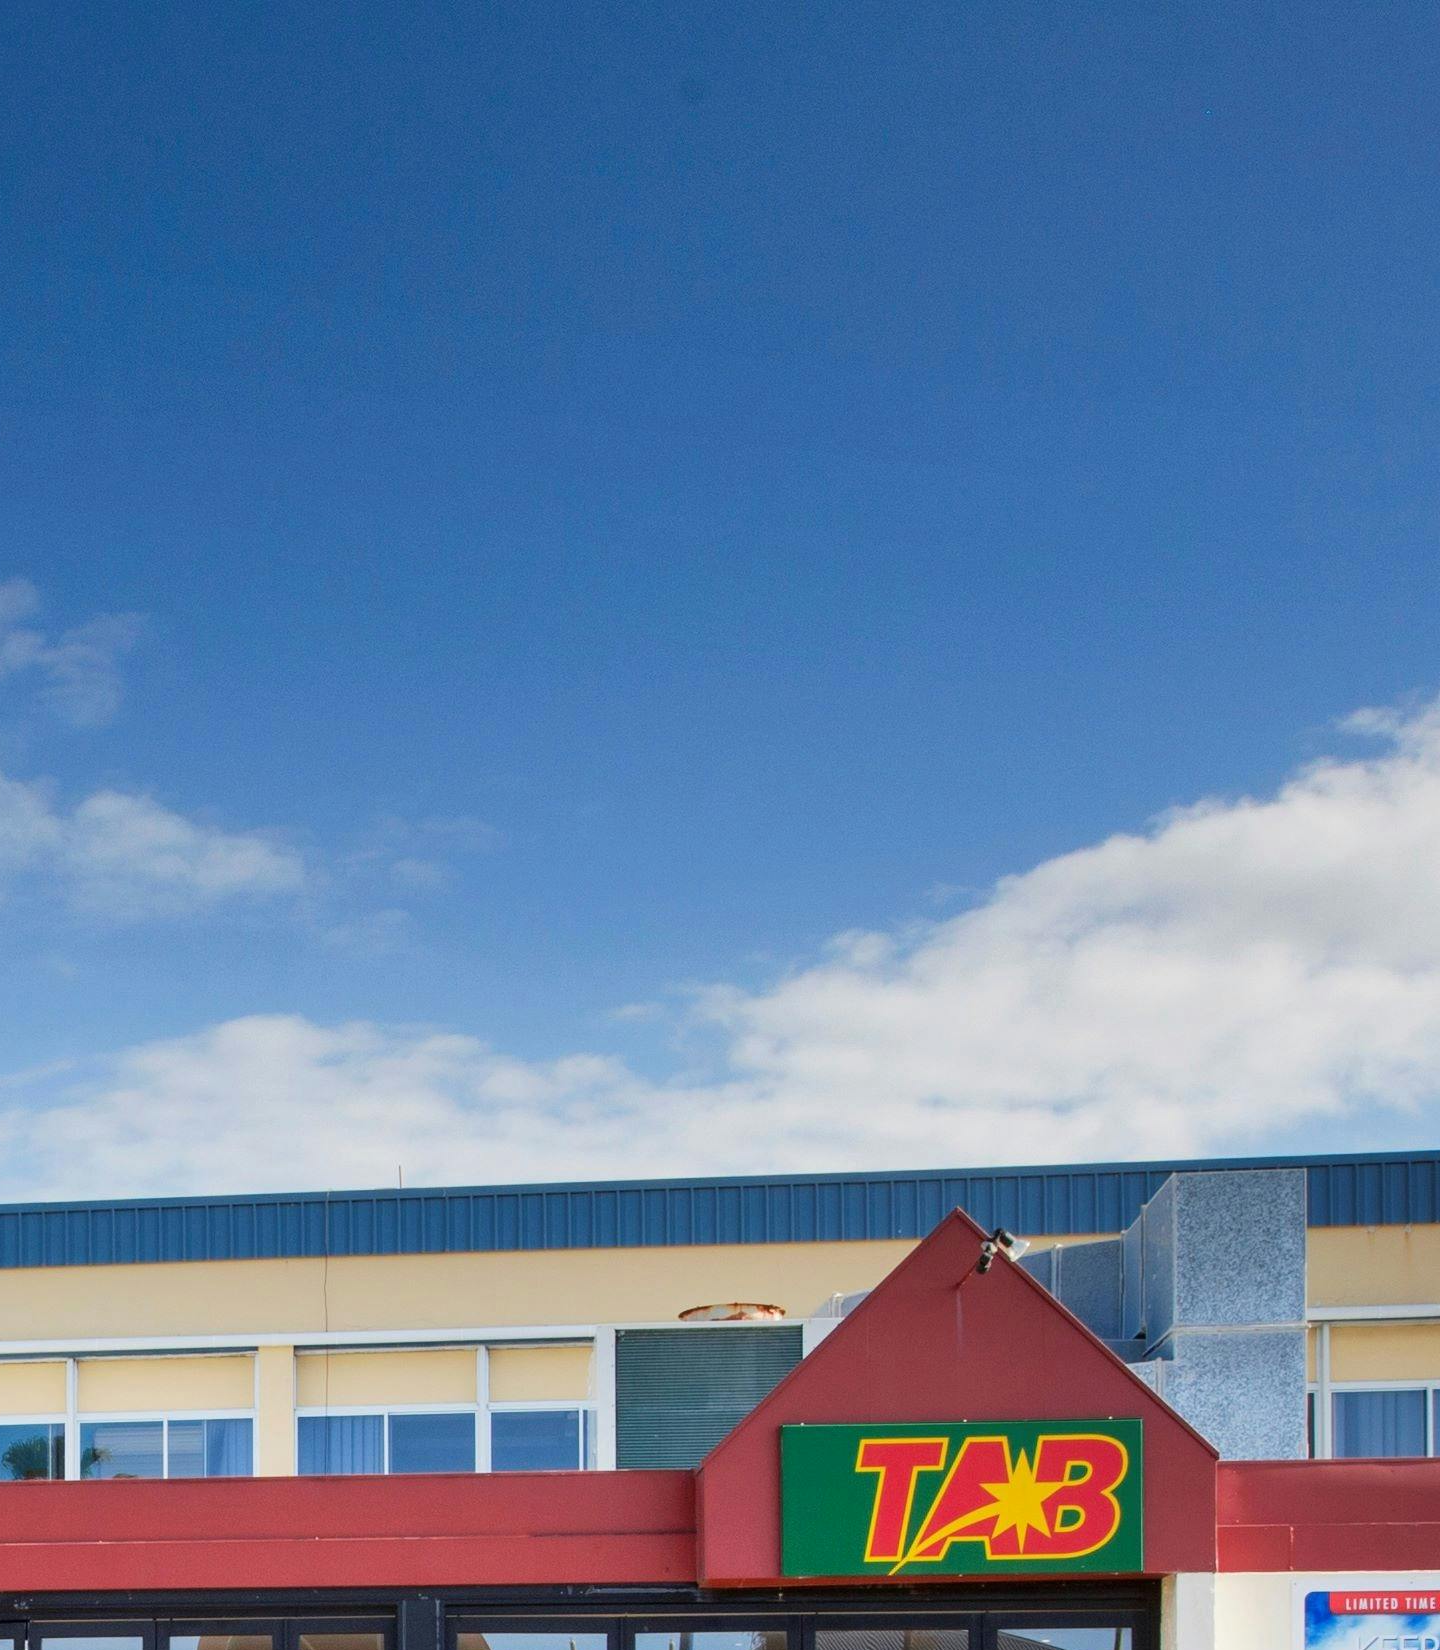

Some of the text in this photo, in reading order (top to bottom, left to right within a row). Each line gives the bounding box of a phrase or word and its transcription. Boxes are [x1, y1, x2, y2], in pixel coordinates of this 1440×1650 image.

[855, 1433, 1129, 1562] TAB
[1345, 1598, 1398, 1611] LIMITED
[1406, 1597, 1436, 1610] TIME
